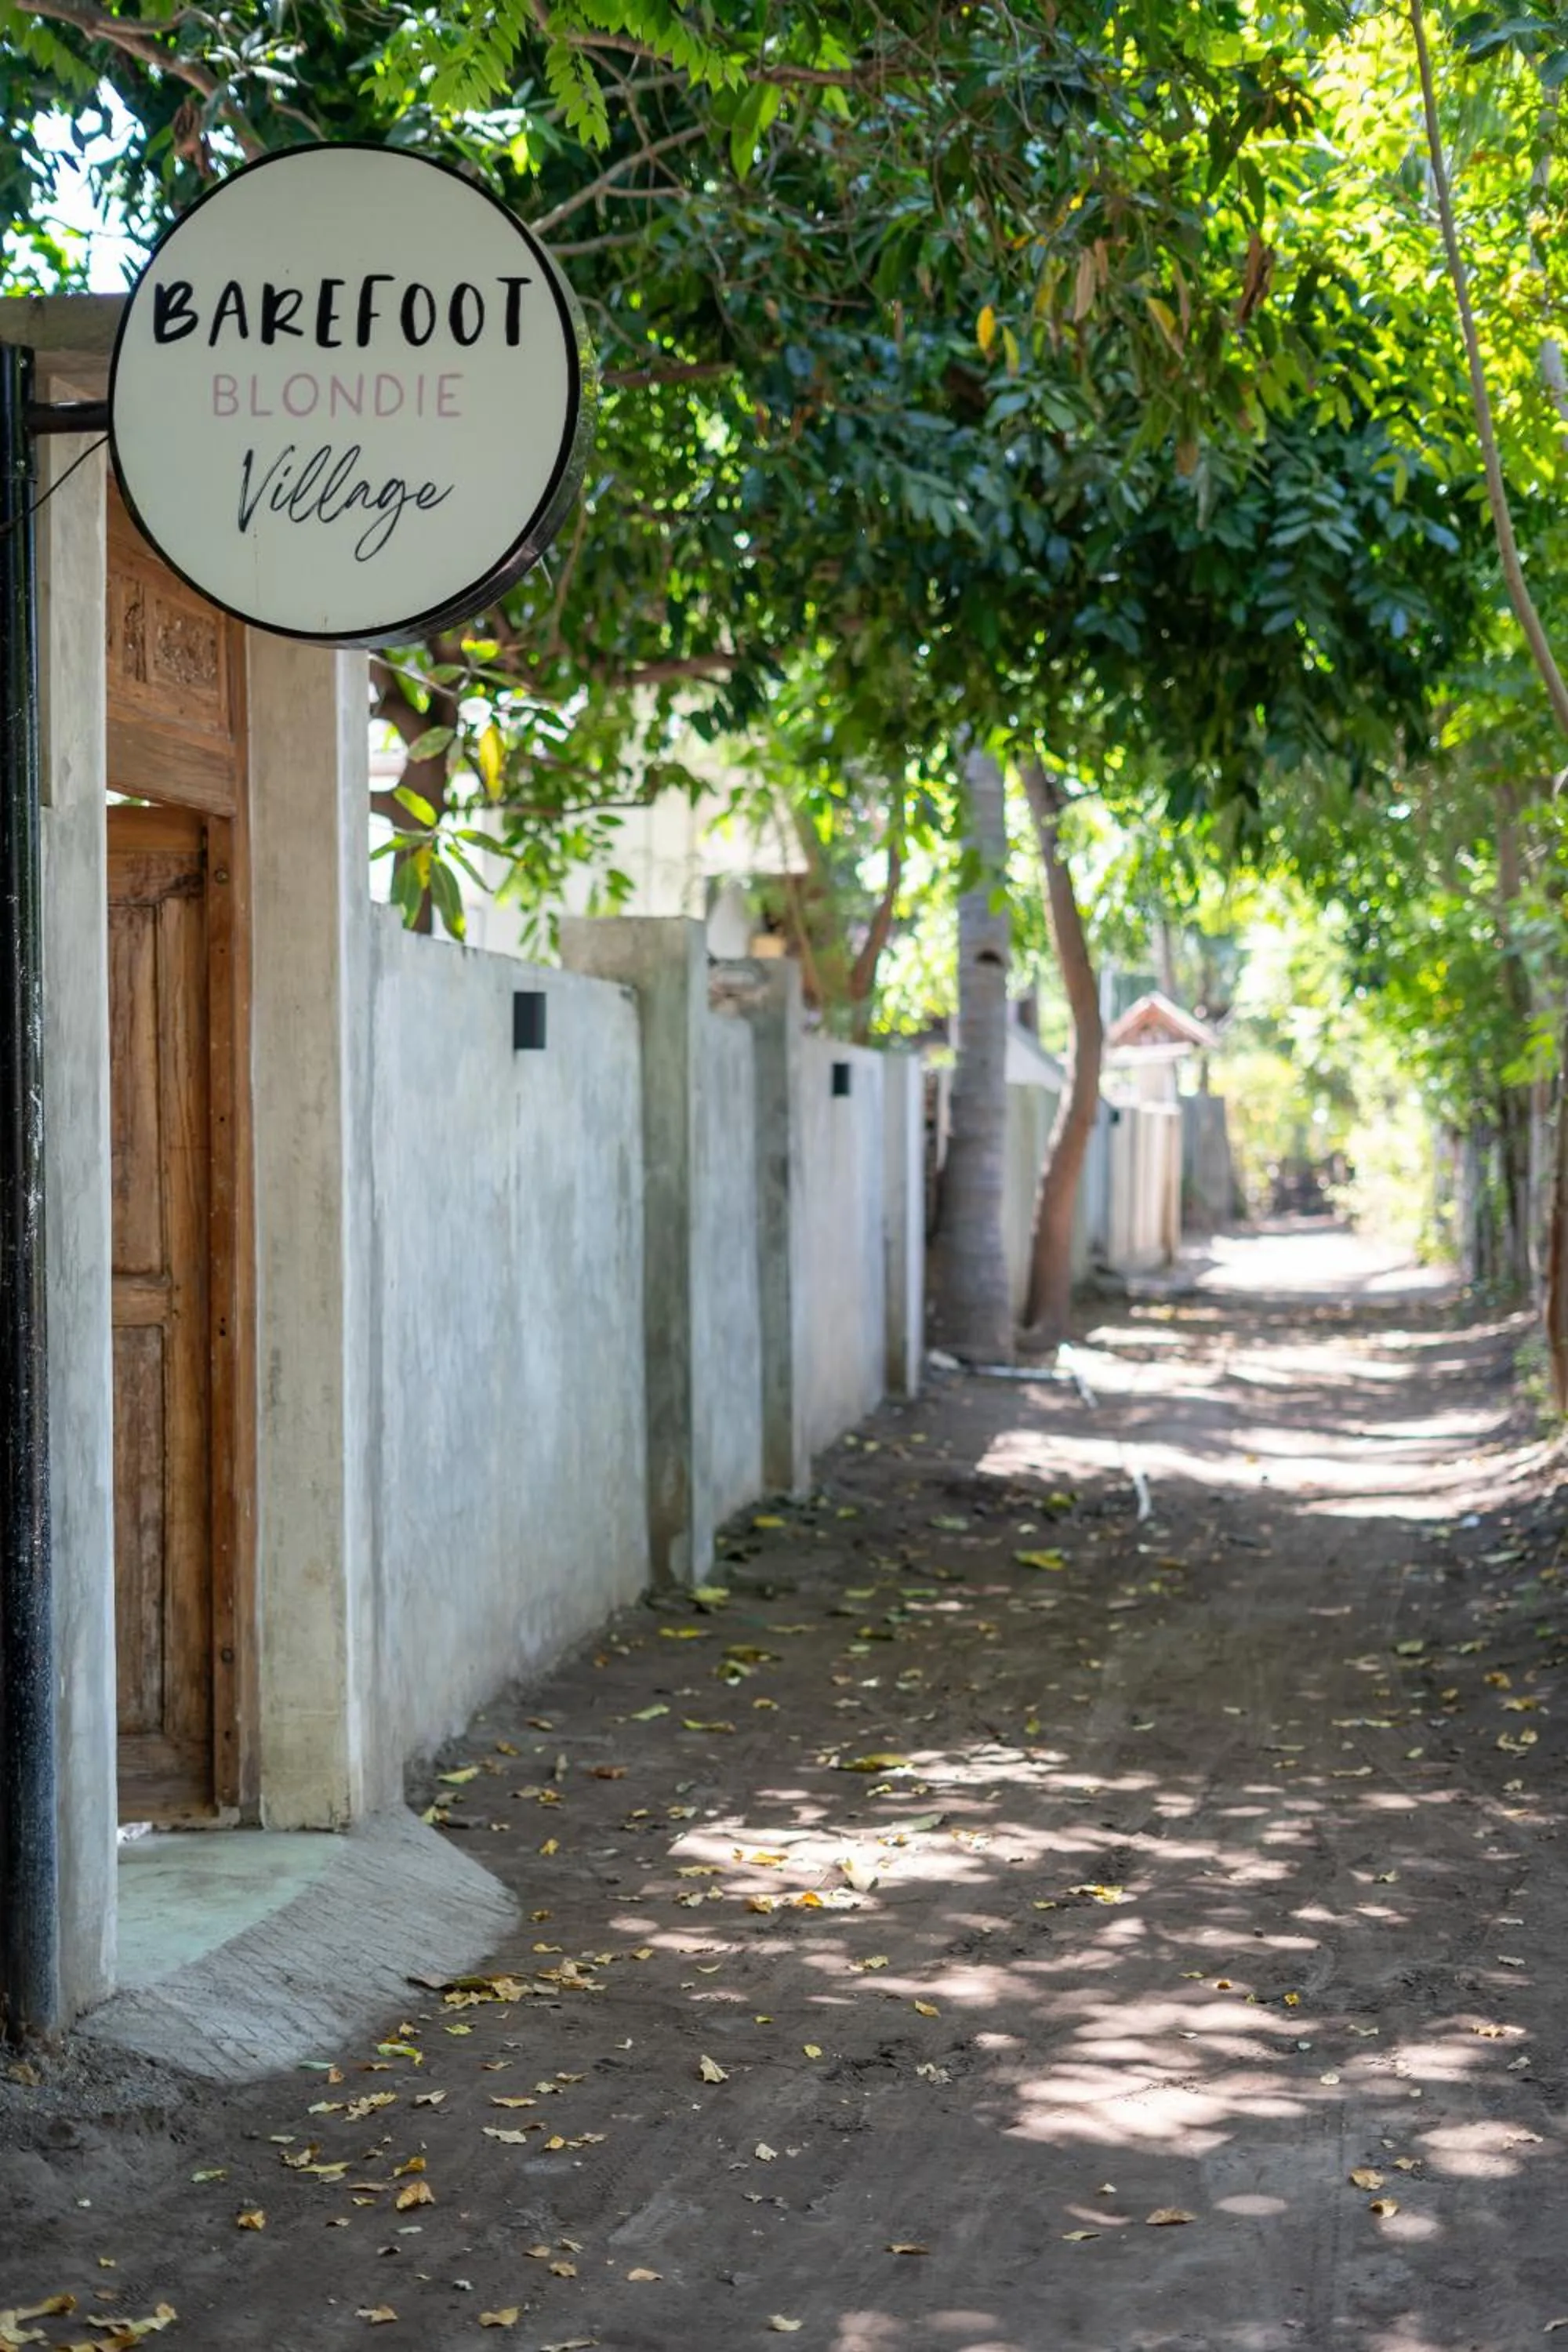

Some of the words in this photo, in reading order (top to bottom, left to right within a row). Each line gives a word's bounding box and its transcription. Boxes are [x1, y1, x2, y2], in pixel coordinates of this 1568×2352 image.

[152, 274, 533, 349] BAREFOOT
[212, 372, 464, 418] BLONDIE
[238, 445, 455, 563] Village
